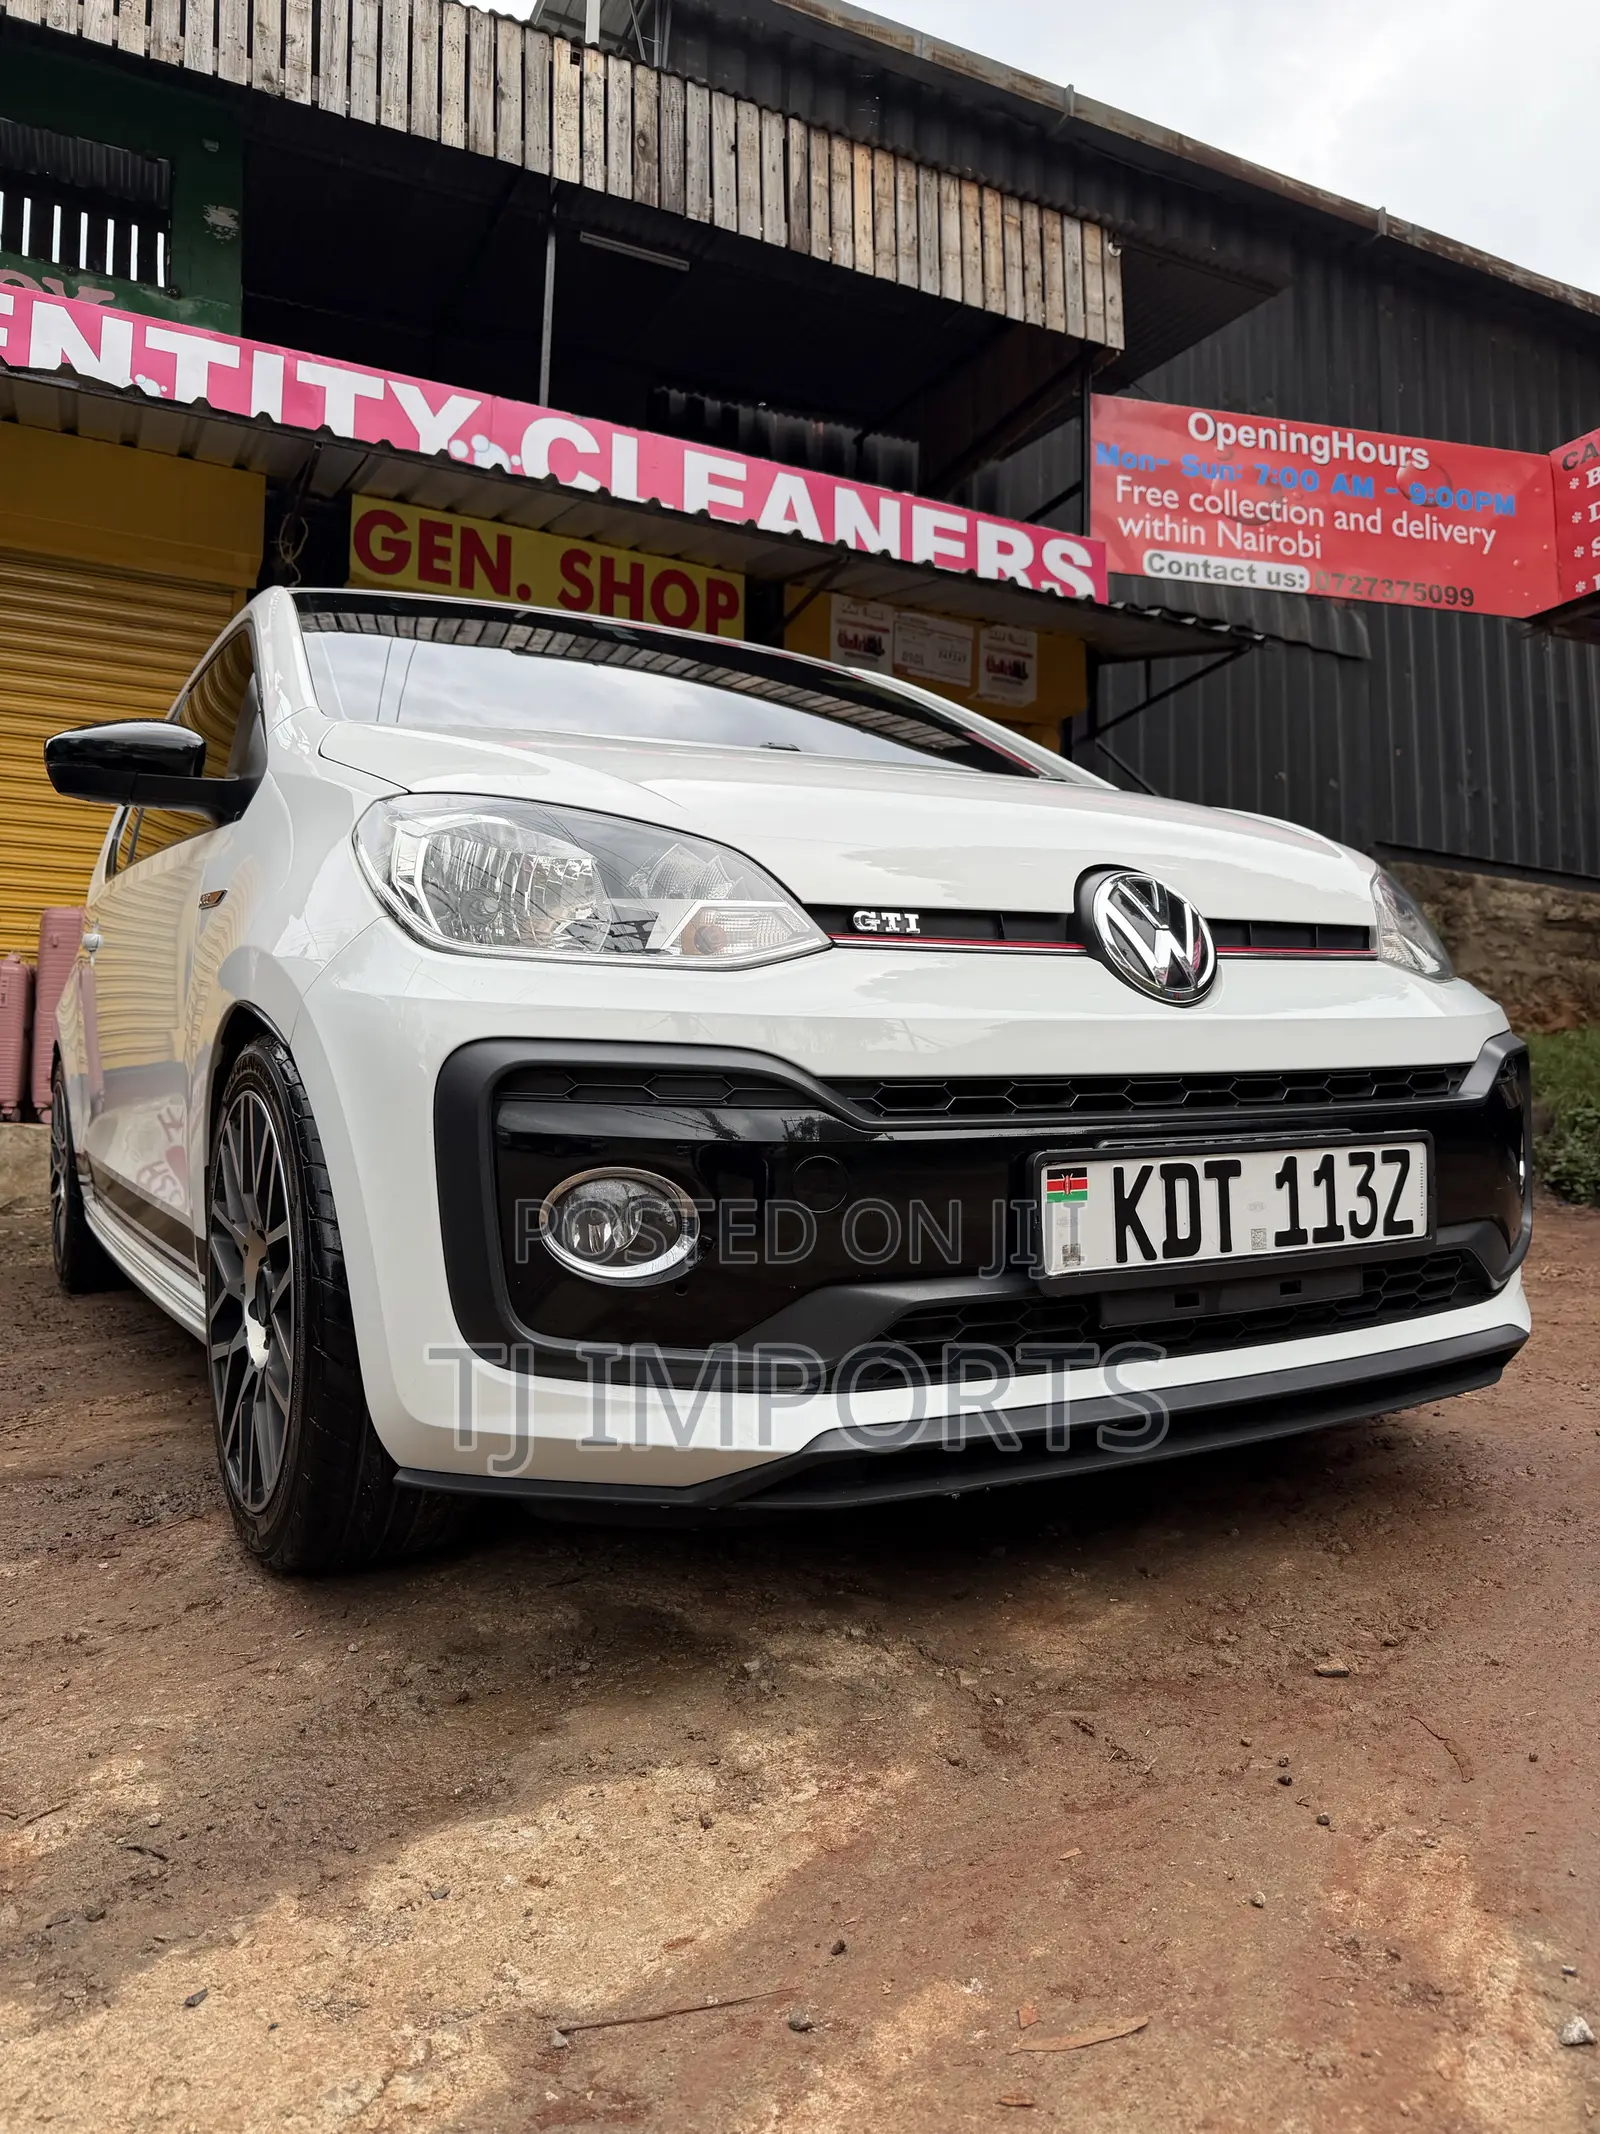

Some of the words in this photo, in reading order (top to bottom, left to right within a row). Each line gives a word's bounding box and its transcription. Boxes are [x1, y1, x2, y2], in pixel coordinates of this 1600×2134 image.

[0, 292, 482, 456] NTITY
[521, 418, 1096, 600] CLEANERS
[1116, 475, 1180, 509] Free
[1189, 489, 1325, 528] collection
[1333, 507, 1382, 535] and
[1392, 511, 1497, 555] delivery
[1181, 453, 1243, 481] Sun:
[1254, 463, 1320, 492] 7:00
[1331, 472, 1374, 499] AM
[1408, 482, 1516, 516] 9:00PM
[353, 509, 532, 602] GEN.
[557, 548, 740, 634] SHOP
[1118, 514, 1206, 546] within
[1217, 520, 1322, 560] Nairobi
[1148, 553, 1257, 585] Contact
[1267, 567, 1305, 588] us:
[1314, 571, 1475, 607] 0727375099
[852, 910, 922, 935] GTI
[1113, 1159, 1242, 1264] KDT
[1273, 1148, 1414, 1248] 113Z
